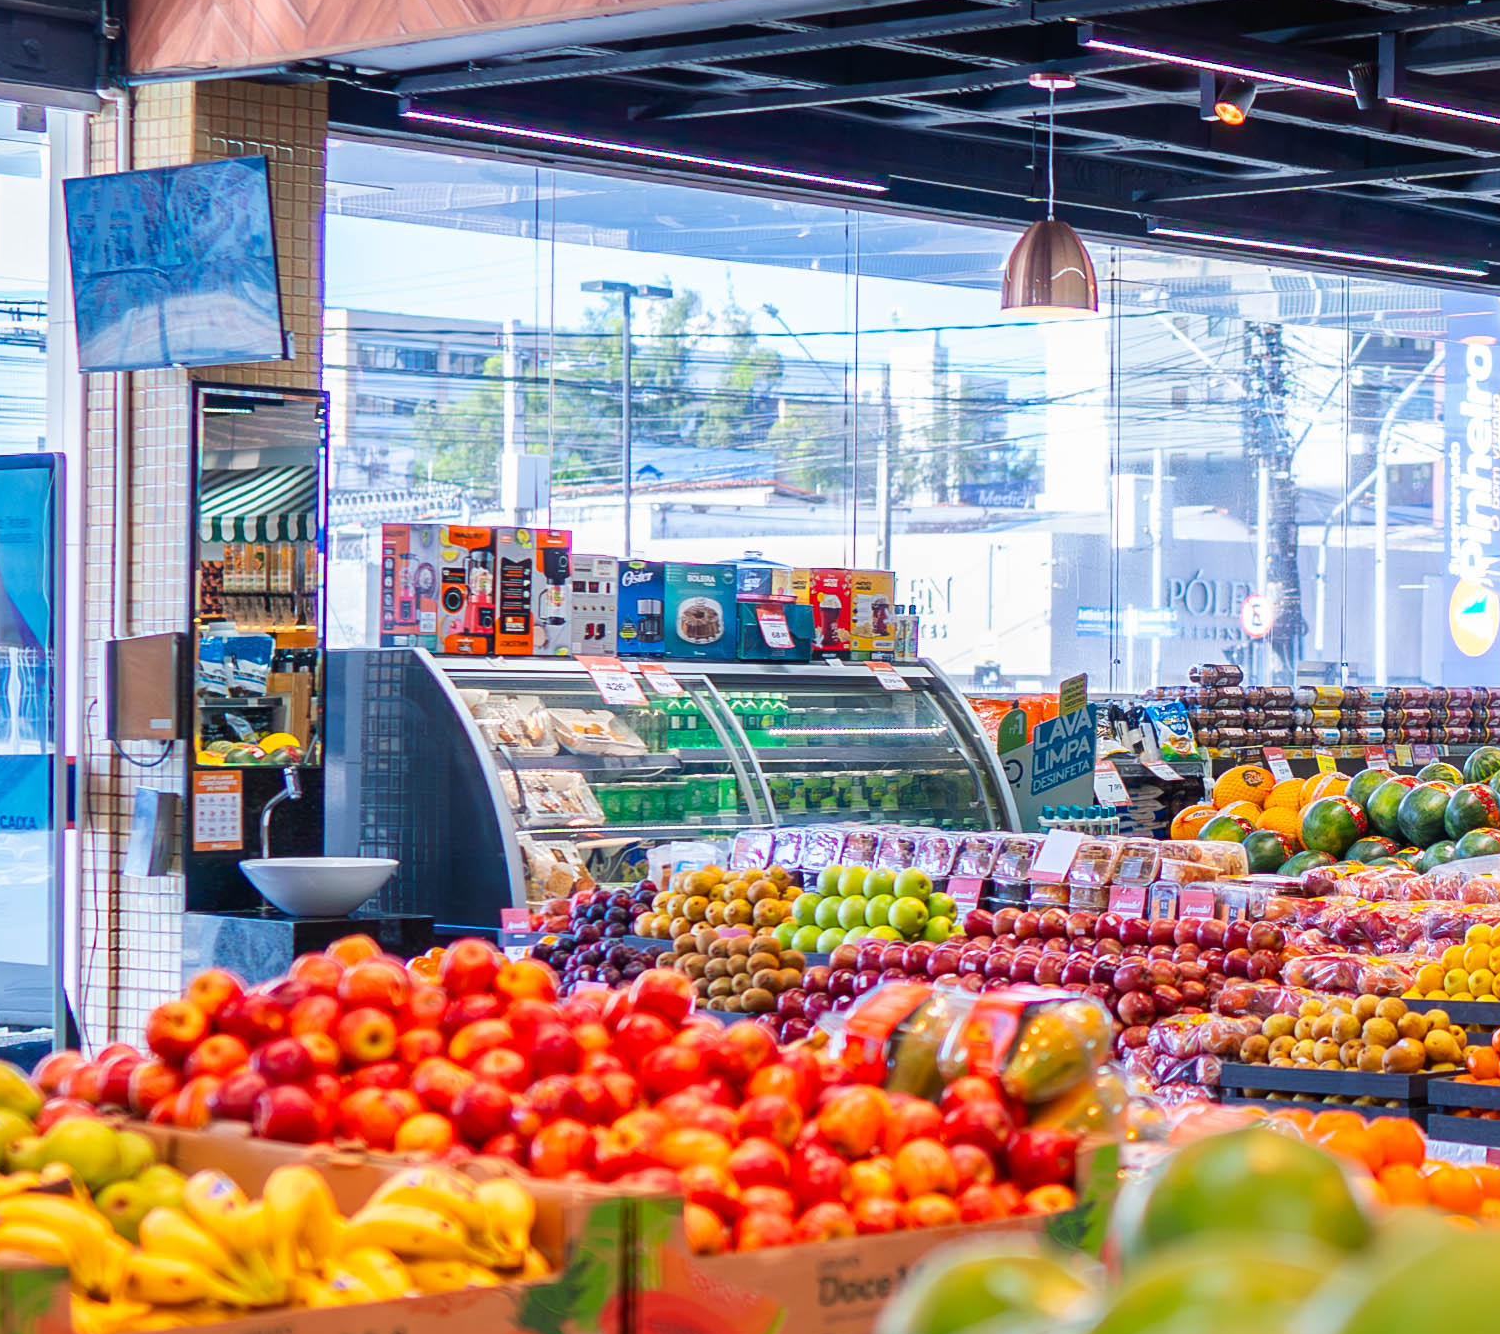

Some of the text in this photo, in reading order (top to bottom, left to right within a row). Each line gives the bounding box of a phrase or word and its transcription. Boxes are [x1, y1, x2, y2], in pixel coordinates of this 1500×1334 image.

[621, 569, 654, 587] Oster
[1035, 705, 1093, 750] LAVA
[1034, 735, 1092, 775] LIMPA
[1032, 759, 1091, 793] DESINFETA
[0, 815, 38, 830] CAIXA
